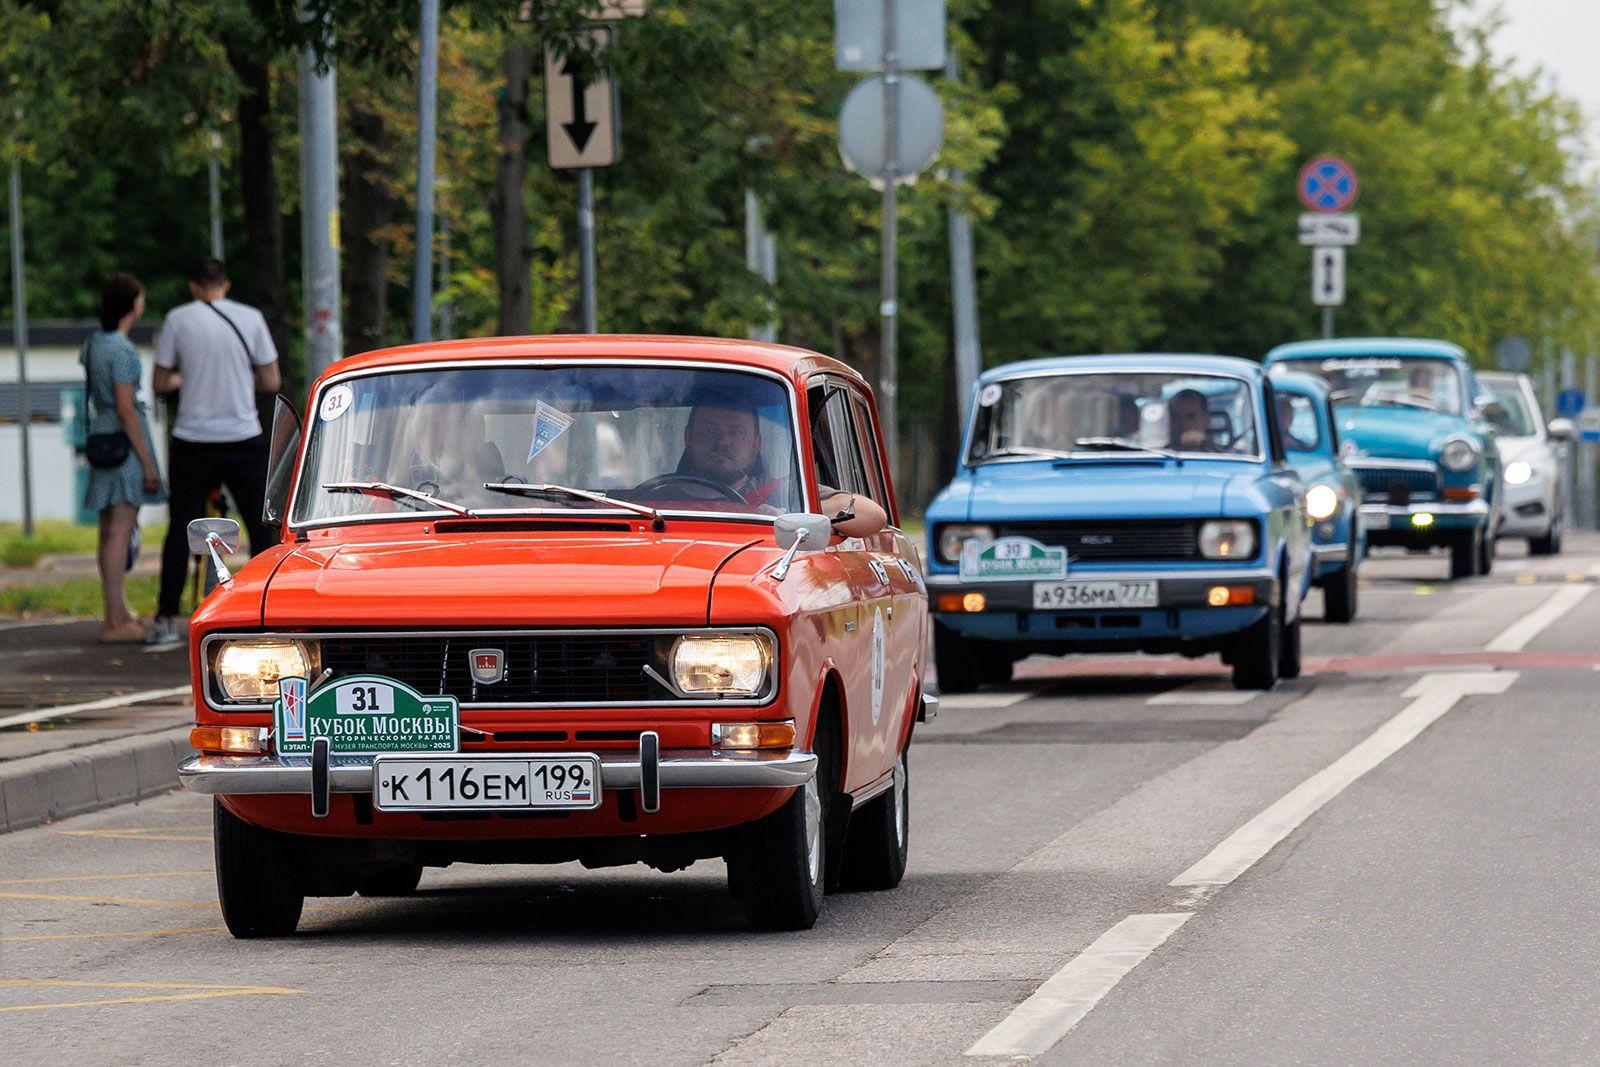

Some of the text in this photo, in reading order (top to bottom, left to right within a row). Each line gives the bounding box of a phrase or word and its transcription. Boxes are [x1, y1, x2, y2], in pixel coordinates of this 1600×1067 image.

[328, 394, 342, 411] 31
[1041, 583, 1150, 604] А936МА 777
[351, 687, 380, 711] 31
[309, 716, 450, 735] КУБОК МОСКВЫ
[391, 764, 584, 801] К116ЕМ 199
[545, 791, 571, 800] RUS
